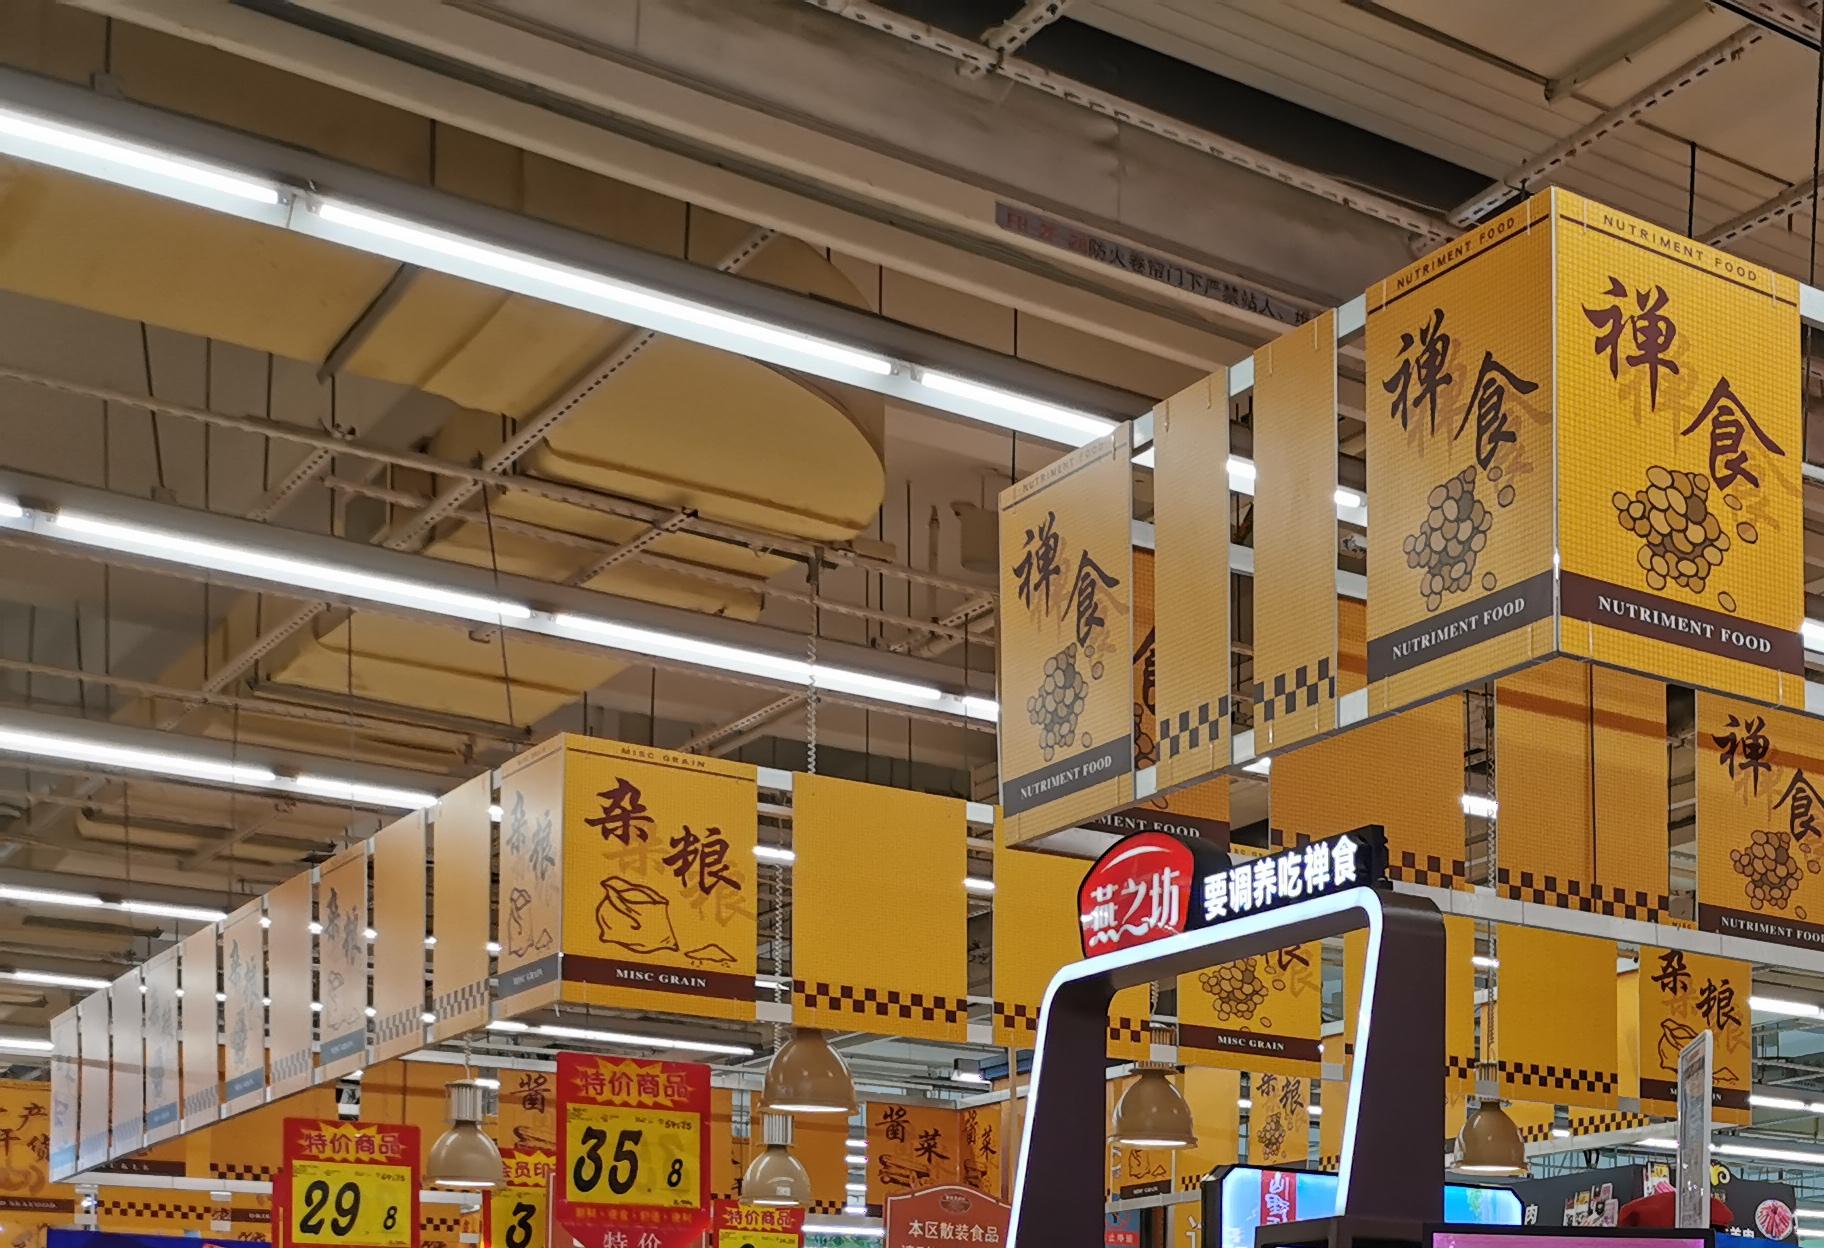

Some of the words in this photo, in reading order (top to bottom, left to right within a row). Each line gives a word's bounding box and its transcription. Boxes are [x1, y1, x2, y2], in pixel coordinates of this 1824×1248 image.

[1397, 242, 1472, 288] NUTRIMENT
[1478, 216, 1516, 243] FOOD
[1603, 214, 1704, 263] NUTRIMENT
[1712, 252, 1759, 283] FOOD
[1382, 307, 1540, 470] 禅食
[1580, 275, 1787, 490] 禅食
[1013, 510, 1121, 648] 禅食
[1391, 613, 1480, 661] NUTRIMENT
[1484, 596, 1527, 628] FOOD
[1598, 595, 1715, 642] NUTRIMENT
[1720, 626, 1773, 654] FOOD
[620, 746, 655, 760] MISC
[662, 755, 706, 768] GRAIN
[1020, 766, 1079, 800] NUTRIMENT
[1083, 755, 1113, 776] FOOD
[584, 775, 743, 896] 杂粮
[1088, 865, 1181, 945] 燕之坊
[1203, 834, 1358, 922] 要调养吃禅食
[1719, 914, 1793, 940] NUTRIMENT
[615, 967, 655, 982] MISC
[659, 971, 707, 989] GRAIN
[1650, 947, 1742, 1028] 杂粮
[1217, 1034, 1247, 1047] MISC
[1250, 1039, 1286, 1052] GRAIN
[582, 1072, 689, 1100] 特价商品
[304, 1134, 401, 1157] 特价商品
[876, 1106, 950, 1166] 酱菜
[726, 1210, 792, 1227] 特价商品
[907, 1220, 1000, 1244] 本区散装食品
